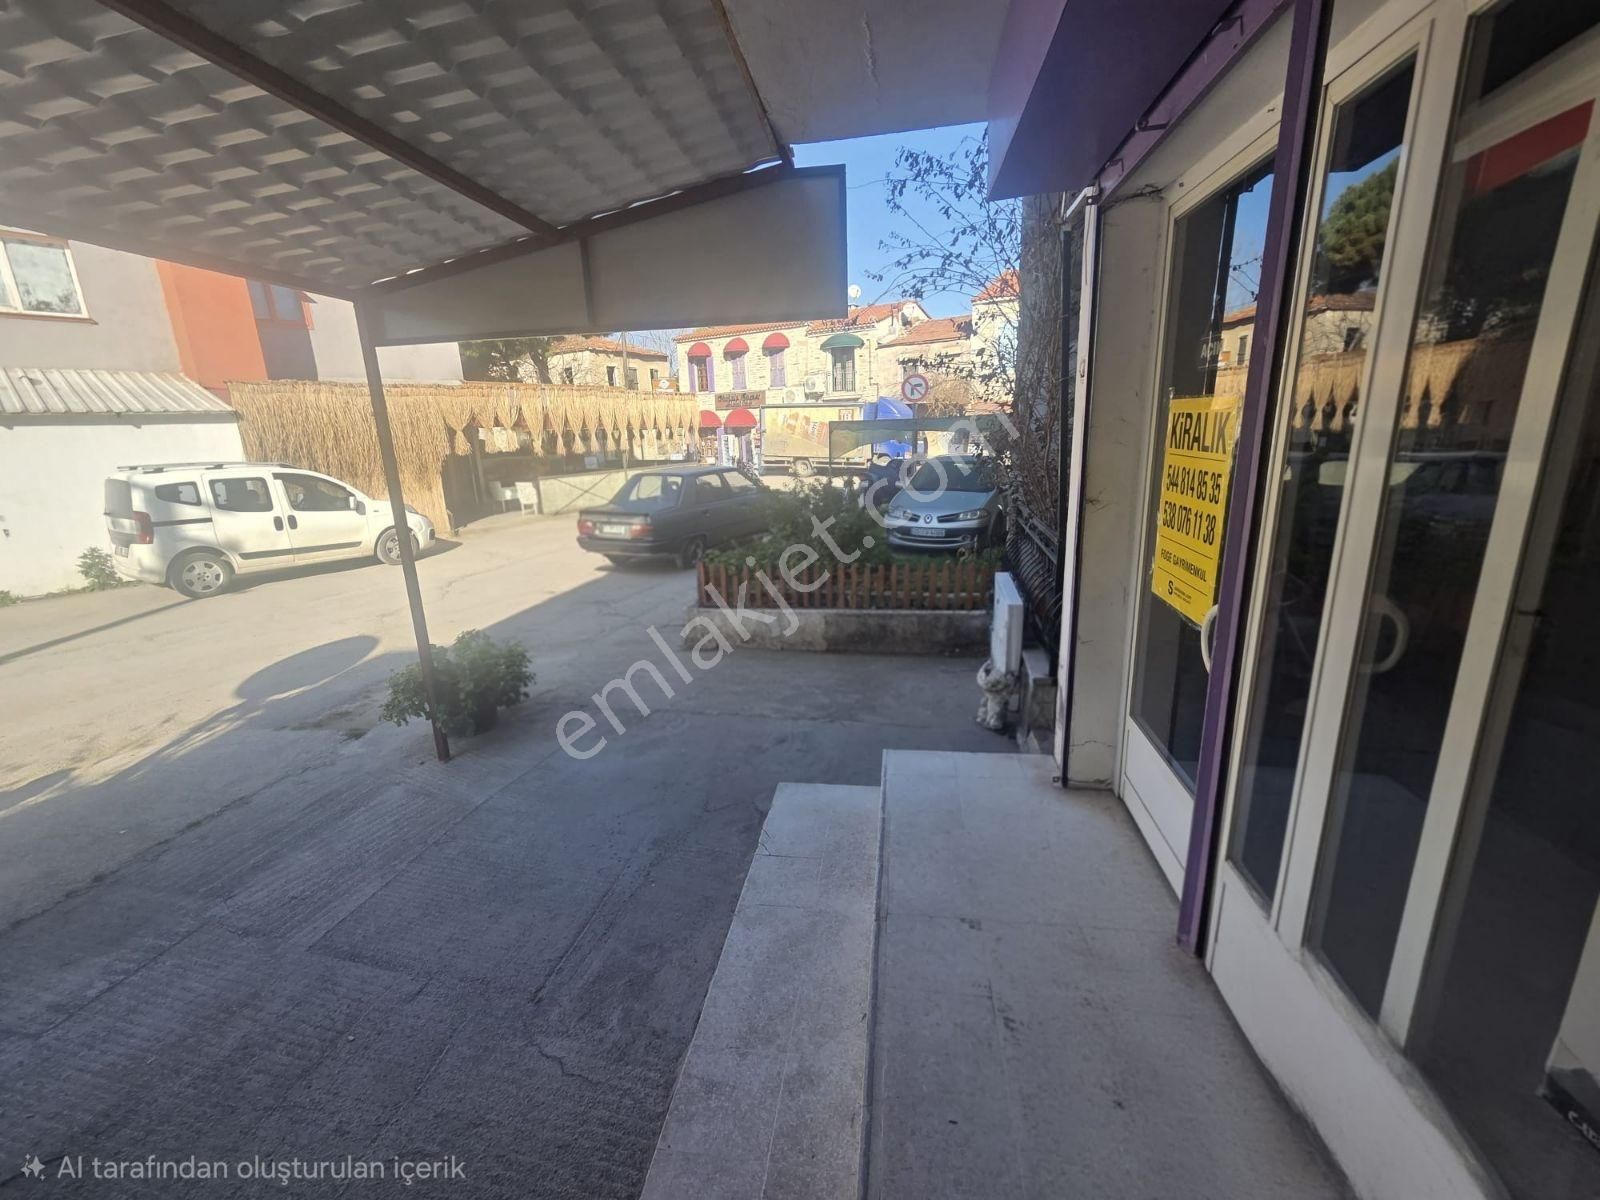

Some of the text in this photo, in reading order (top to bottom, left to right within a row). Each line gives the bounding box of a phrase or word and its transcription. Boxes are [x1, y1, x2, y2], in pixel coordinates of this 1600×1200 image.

[1166, 464, 1221, 505] 544 814 85 35
[1163, 500, 1217, 546] 538 076 11 38
